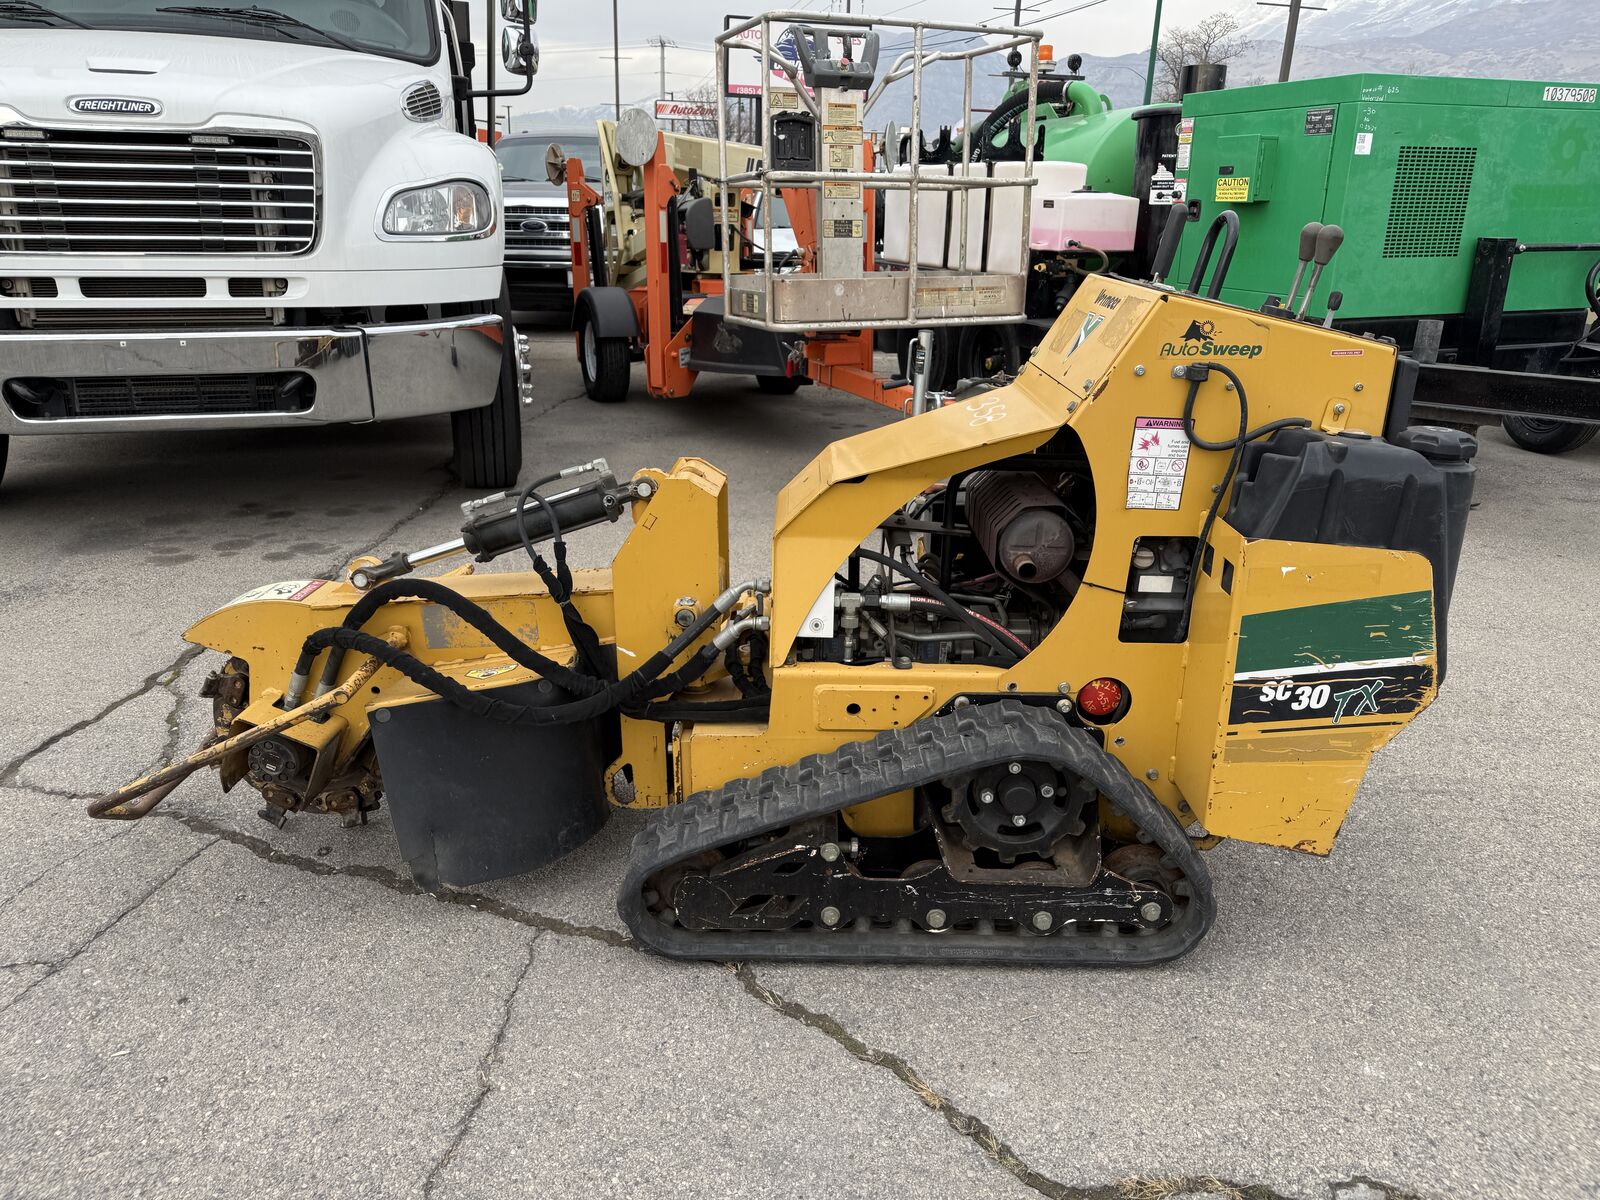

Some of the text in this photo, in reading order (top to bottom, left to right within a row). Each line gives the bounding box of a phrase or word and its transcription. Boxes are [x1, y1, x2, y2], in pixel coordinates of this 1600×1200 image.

[1545, 87, 1596, 102] 10379508
[78, 101, 152, 112] FREIGHTLINER
[1217, 178, 1249, 187] CAUTION
